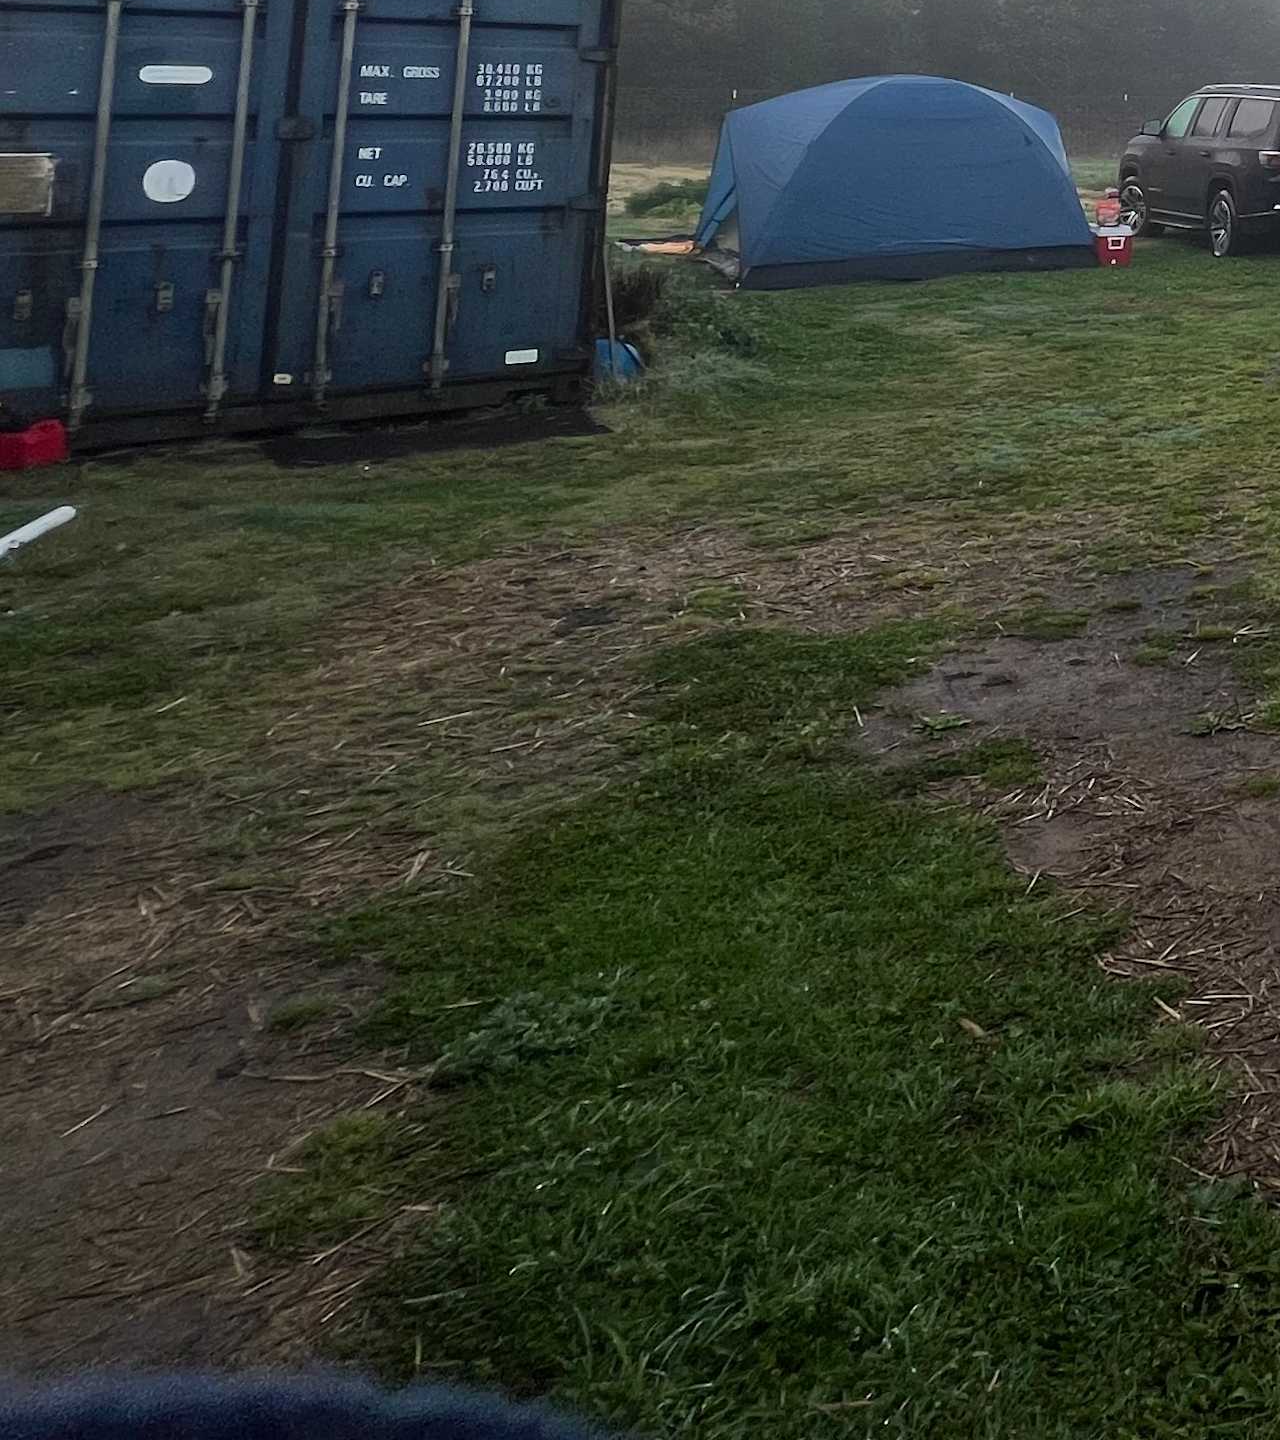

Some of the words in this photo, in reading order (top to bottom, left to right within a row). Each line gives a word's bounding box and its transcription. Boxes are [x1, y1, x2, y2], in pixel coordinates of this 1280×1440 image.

[403, 66, 440, 78] GROSS
[526, 63, 543, 75] KG
[526, 75, 542, 87] LB
[360, 92, 388, 105] TARE
[358, 147, 382, 159] NET
[518, 142, 535, 154] KG
[517, 154, 533, 166] LB
